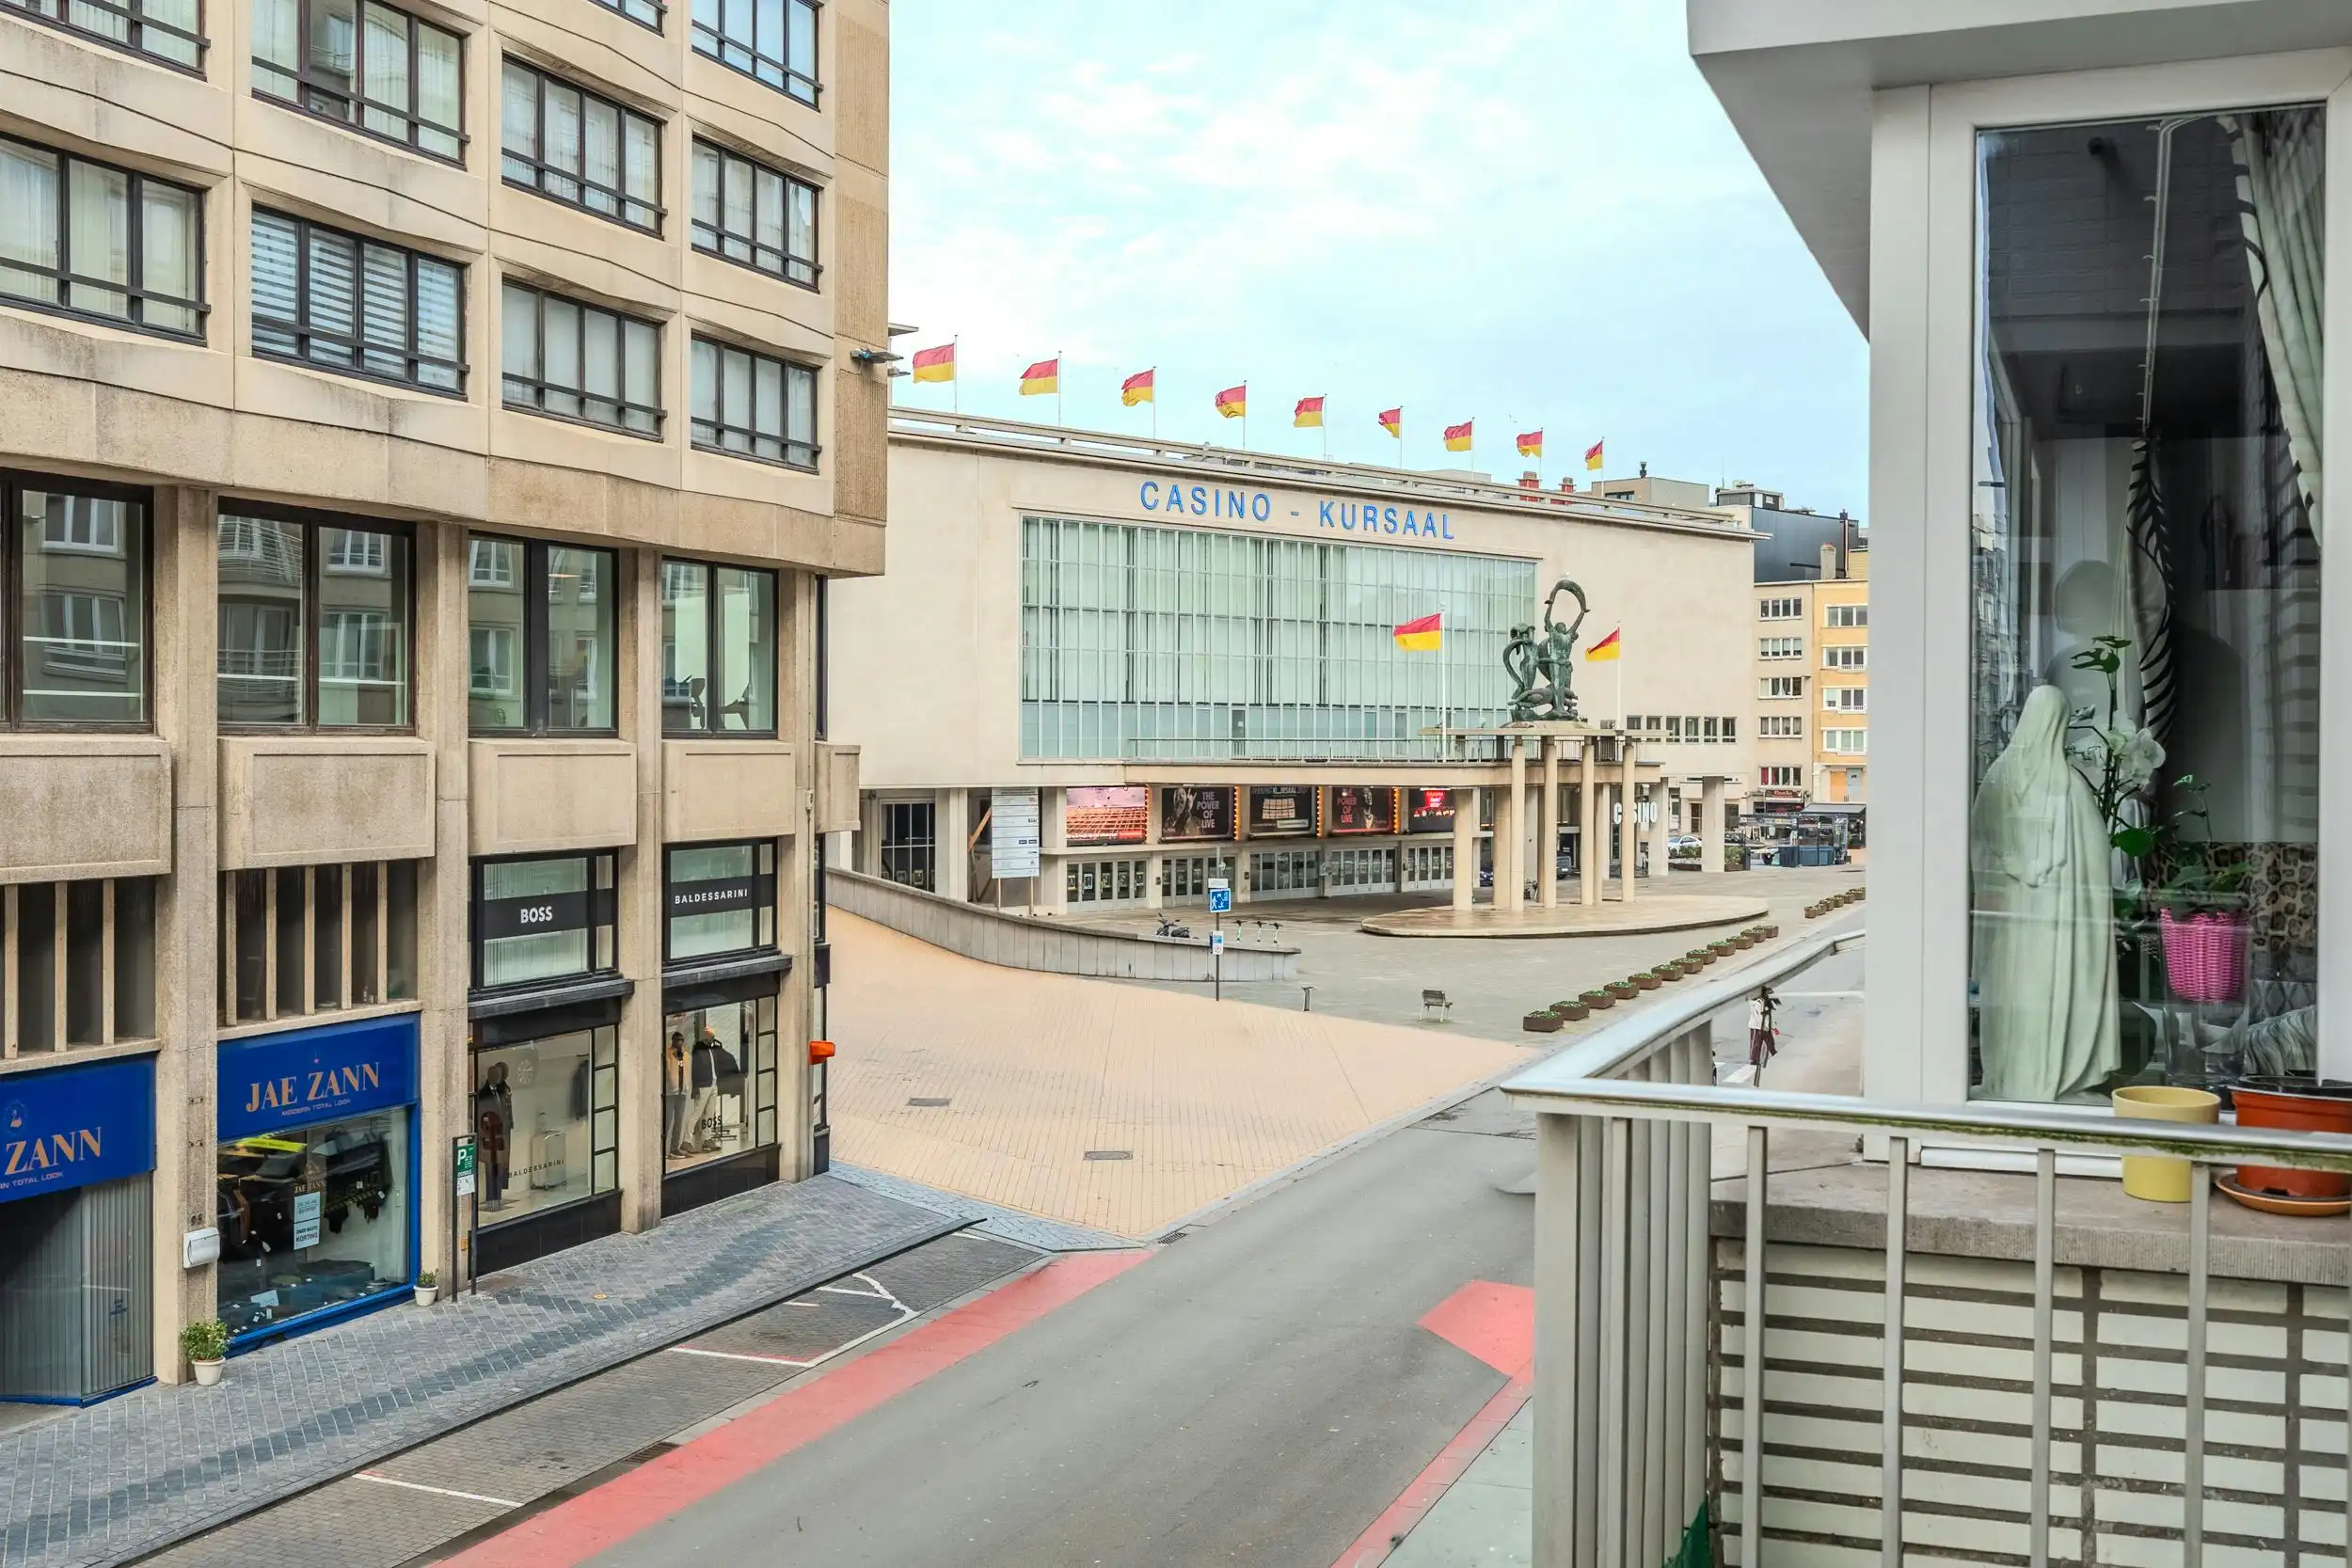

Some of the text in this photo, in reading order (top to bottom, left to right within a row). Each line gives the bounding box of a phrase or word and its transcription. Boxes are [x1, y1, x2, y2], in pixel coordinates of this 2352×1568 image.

[1139, 481, 1271, 522] CASINO
[1319, 500, 1454, 540] KURSAAL
[1201, 791, 1216, 800] THE
[1197, 800, 1220, 810] POWER
[1613, 801, 1658, 825] CSINO
[1202, 810, 1214, 819] OF
[674, 889, 748, 905] BALDESSARINI
[520, 906, 553, 924] BOSS
[246, 1061, 380, 1113] JAE ZANN
[313, 1101, 332, 1110] TOTAL
[701, 1115, 723, 1130] BOSS
[5, 1126, 102, 1176] ZANN
[457, 1148, 467, 1166] P
[508, 1158, 564, 1179] BALDESSARINI
[12, 1176, 39, 1186] TOTAL
[41, 1171, 64, 1181] LOOK
[295, 1231, 318, 1243] KORTING
